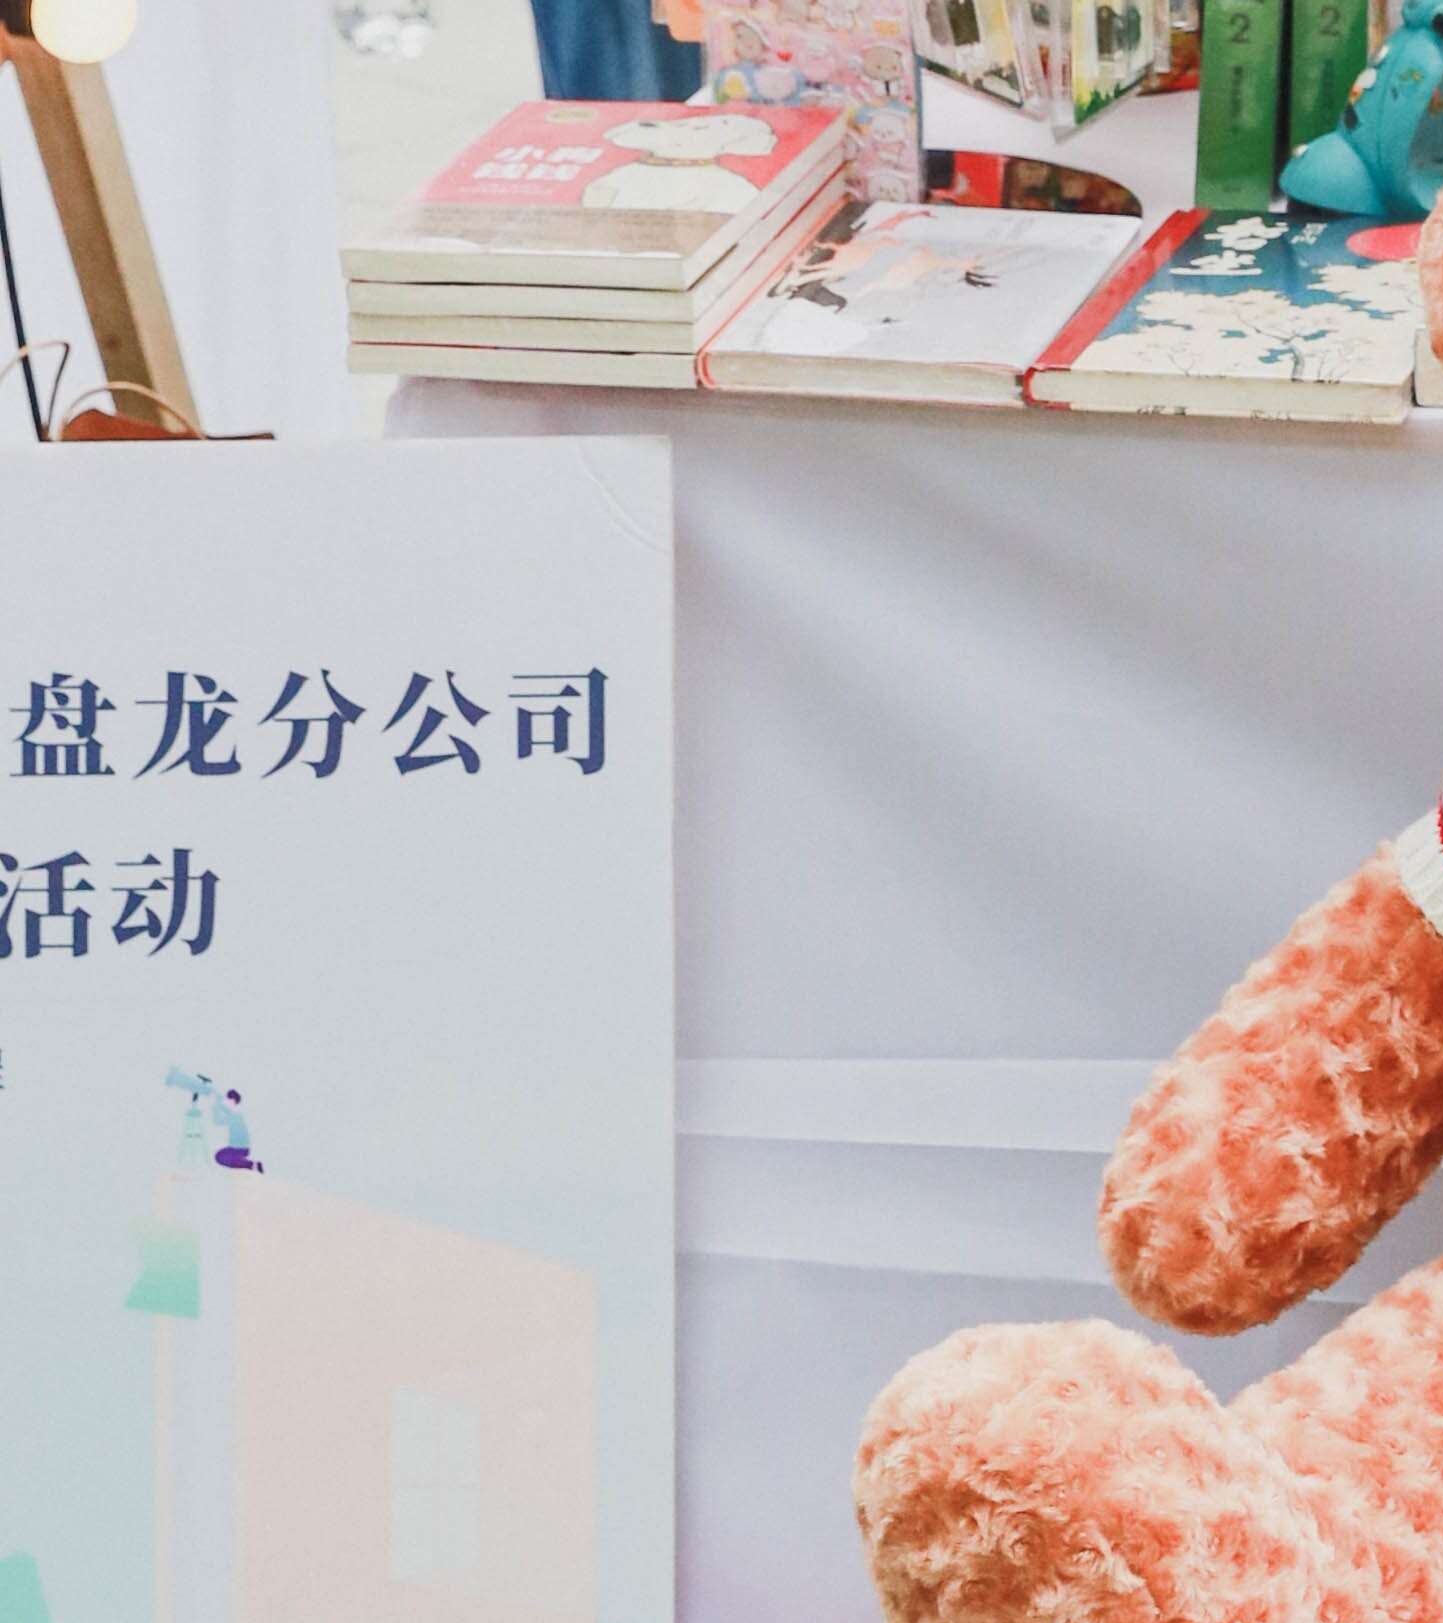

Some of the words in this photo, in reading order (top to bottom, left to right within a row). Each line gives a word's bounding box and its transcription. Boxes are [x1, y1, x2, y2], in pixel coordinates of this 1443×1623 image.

[10, 668, 608, 779] 盘龙分公司
[0, 847, 220, 959] 活动
